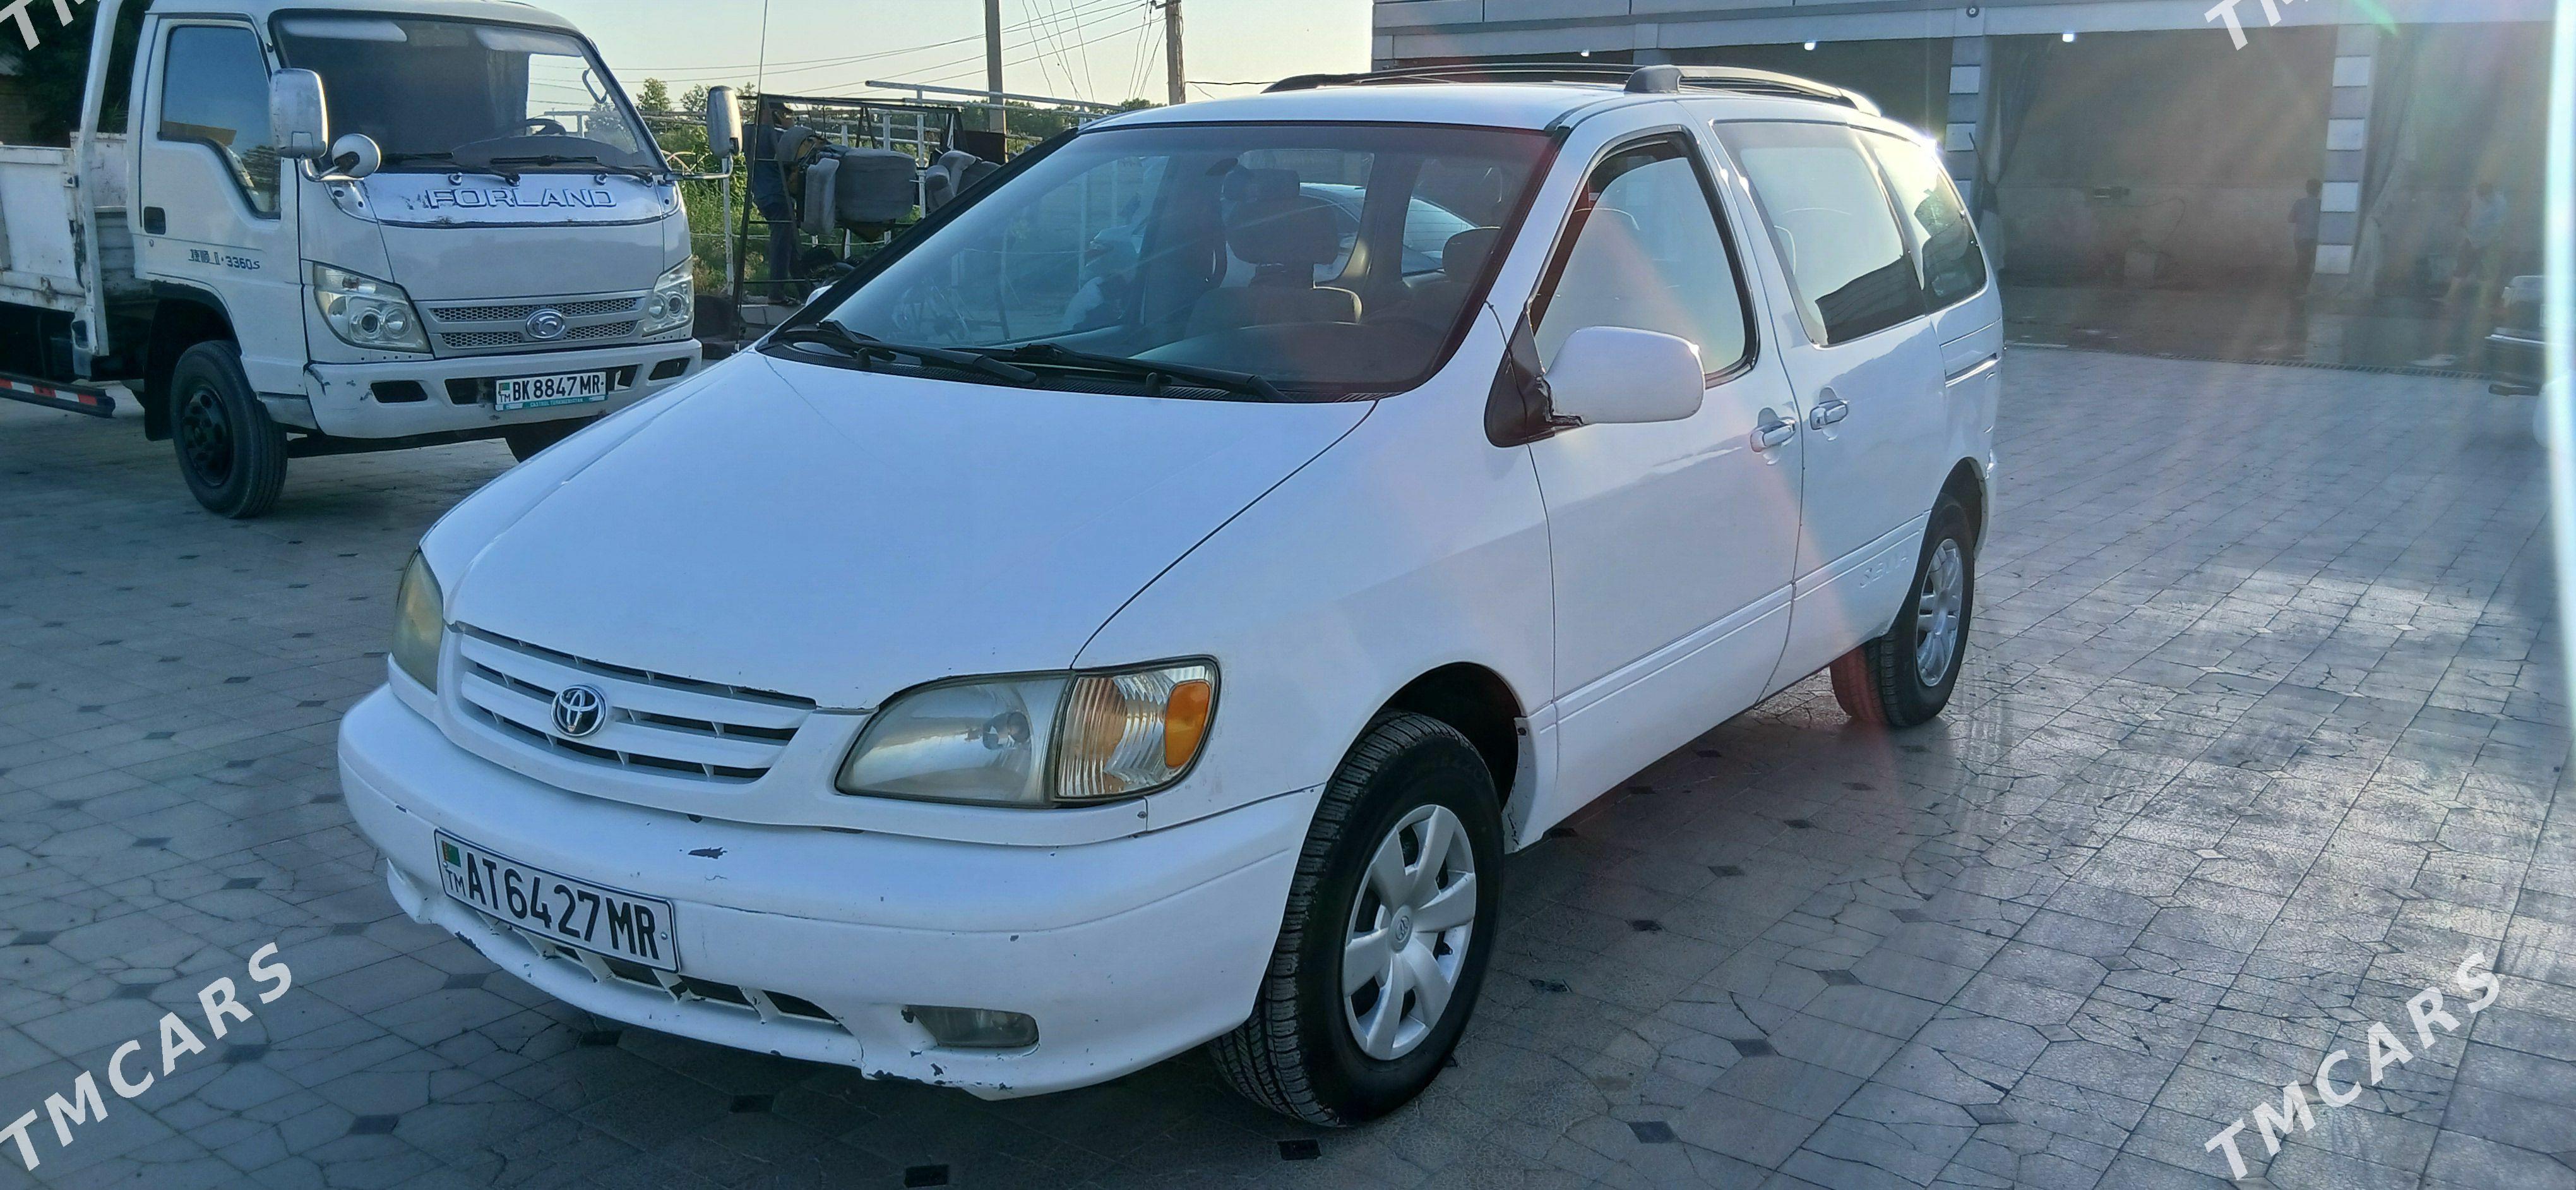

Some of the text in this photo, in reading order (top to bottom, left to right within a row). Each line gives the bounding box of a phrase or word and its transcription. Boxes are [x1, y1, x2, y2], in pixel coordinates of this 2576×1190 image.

[424, 188, 617, 209] FORLAND
[446, 851, 660, 960] TM AT6427MR
